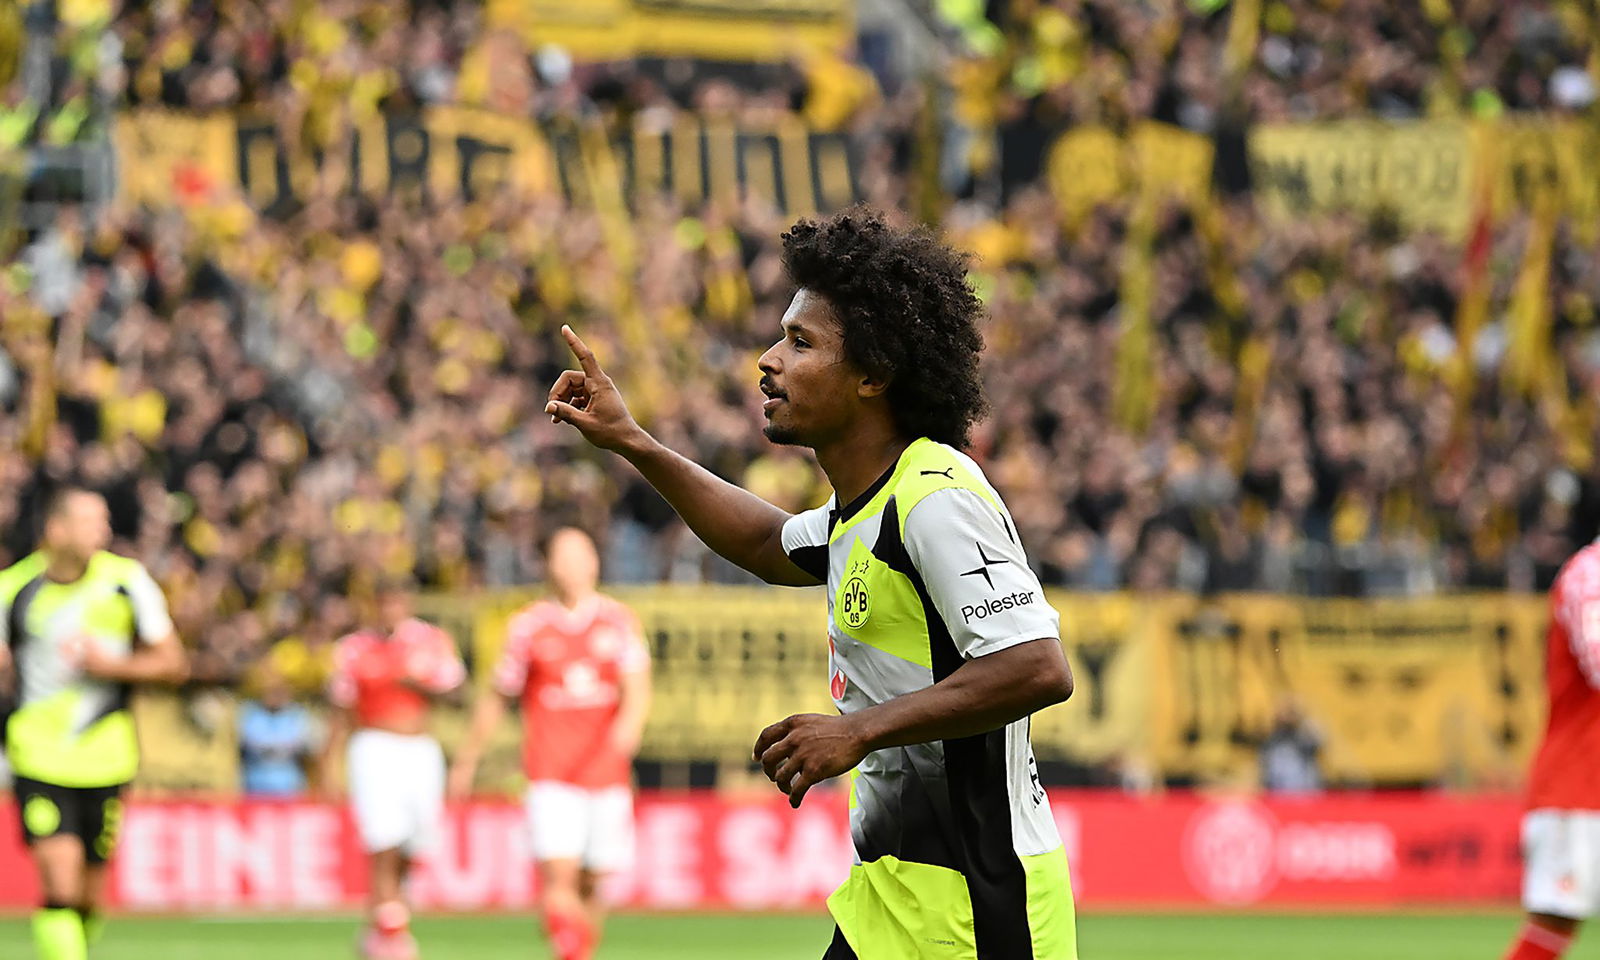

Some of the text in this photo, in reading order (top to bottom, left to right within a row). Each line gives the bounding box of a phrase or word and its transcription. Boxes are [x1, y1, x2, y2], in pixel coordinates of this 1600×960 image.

[844, 582, 867, 613] BVB
[961, 591, 1034, 625] Polestar
[850, 612, 860, 623] 09
[121, 806, 343, 907] EINE
